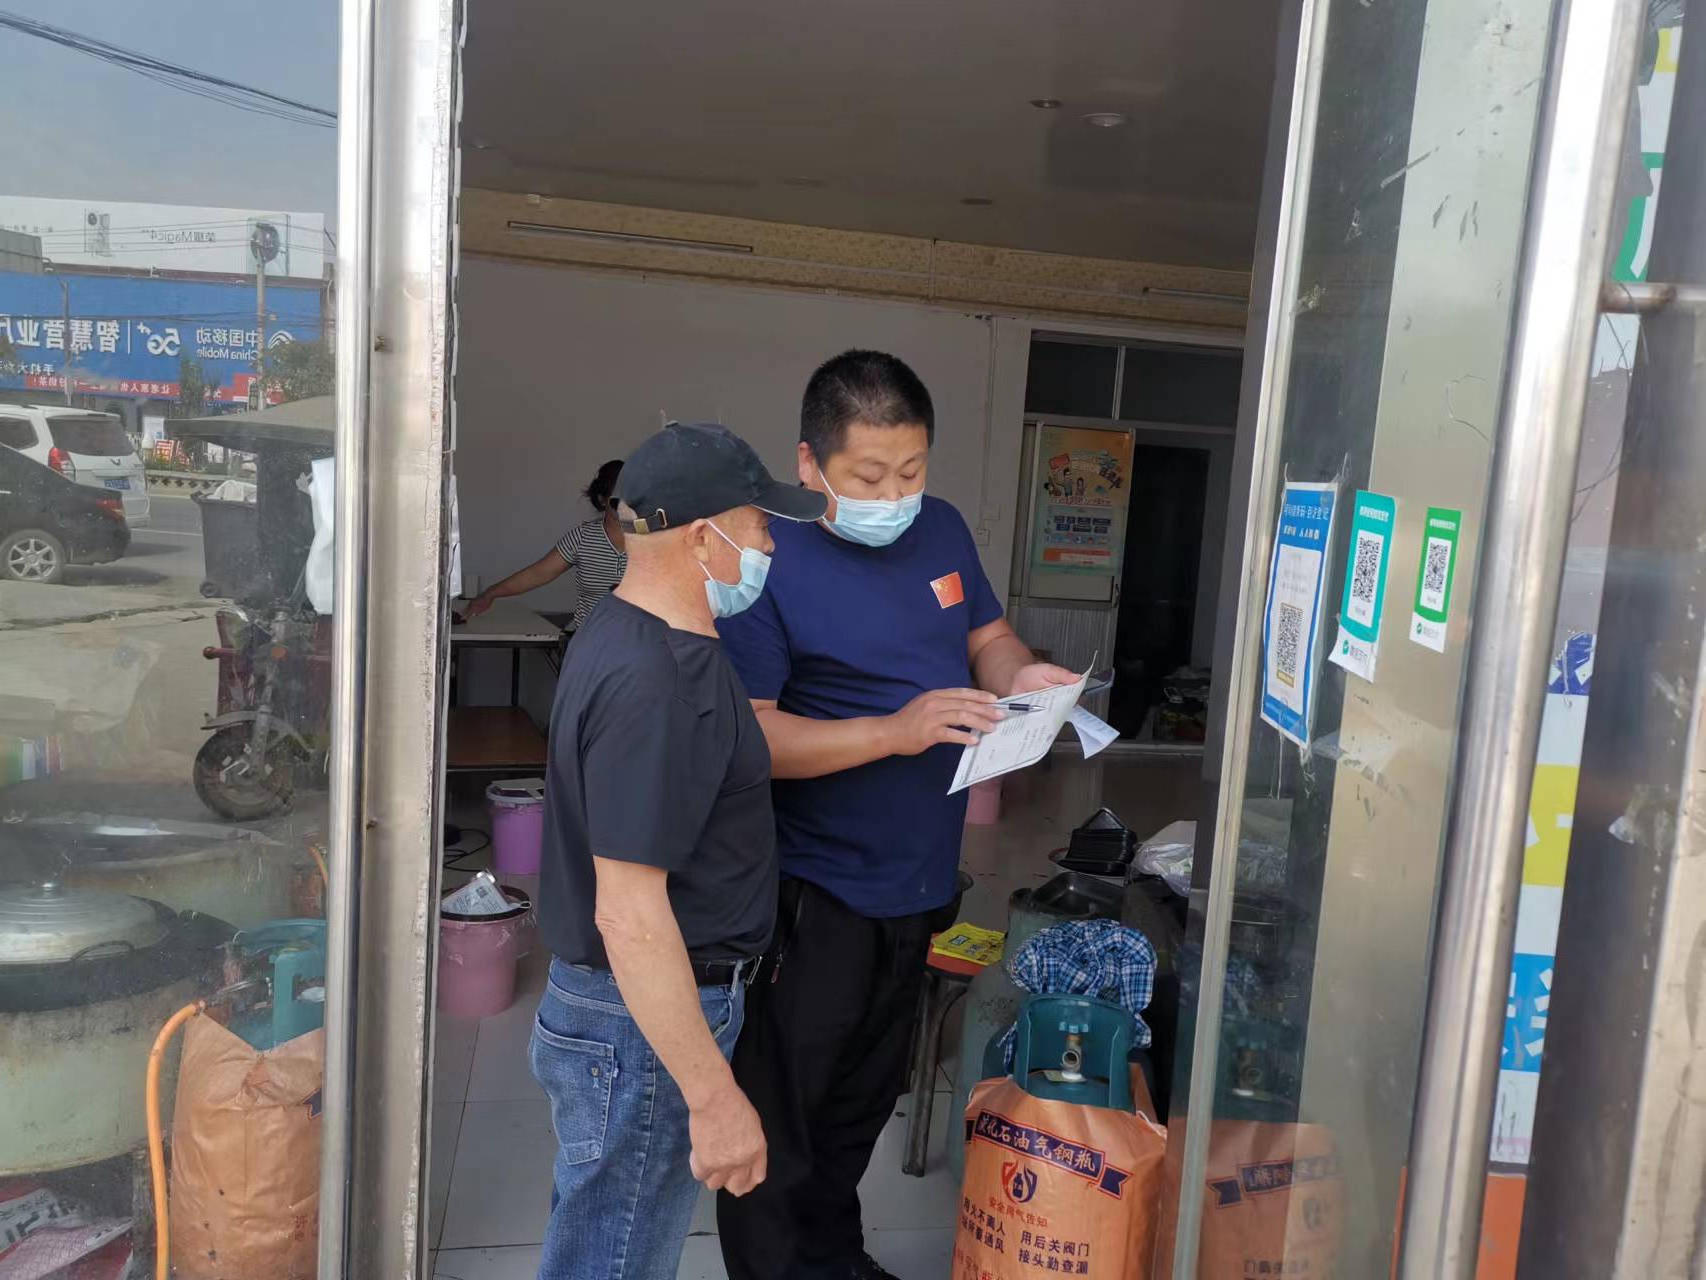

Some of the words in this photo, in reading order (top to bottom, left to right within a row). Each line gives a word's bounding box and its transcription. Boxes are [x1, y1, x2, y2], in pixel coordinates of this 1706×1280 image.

[1020, 1230, 1091, 1258] 用后关阀门
